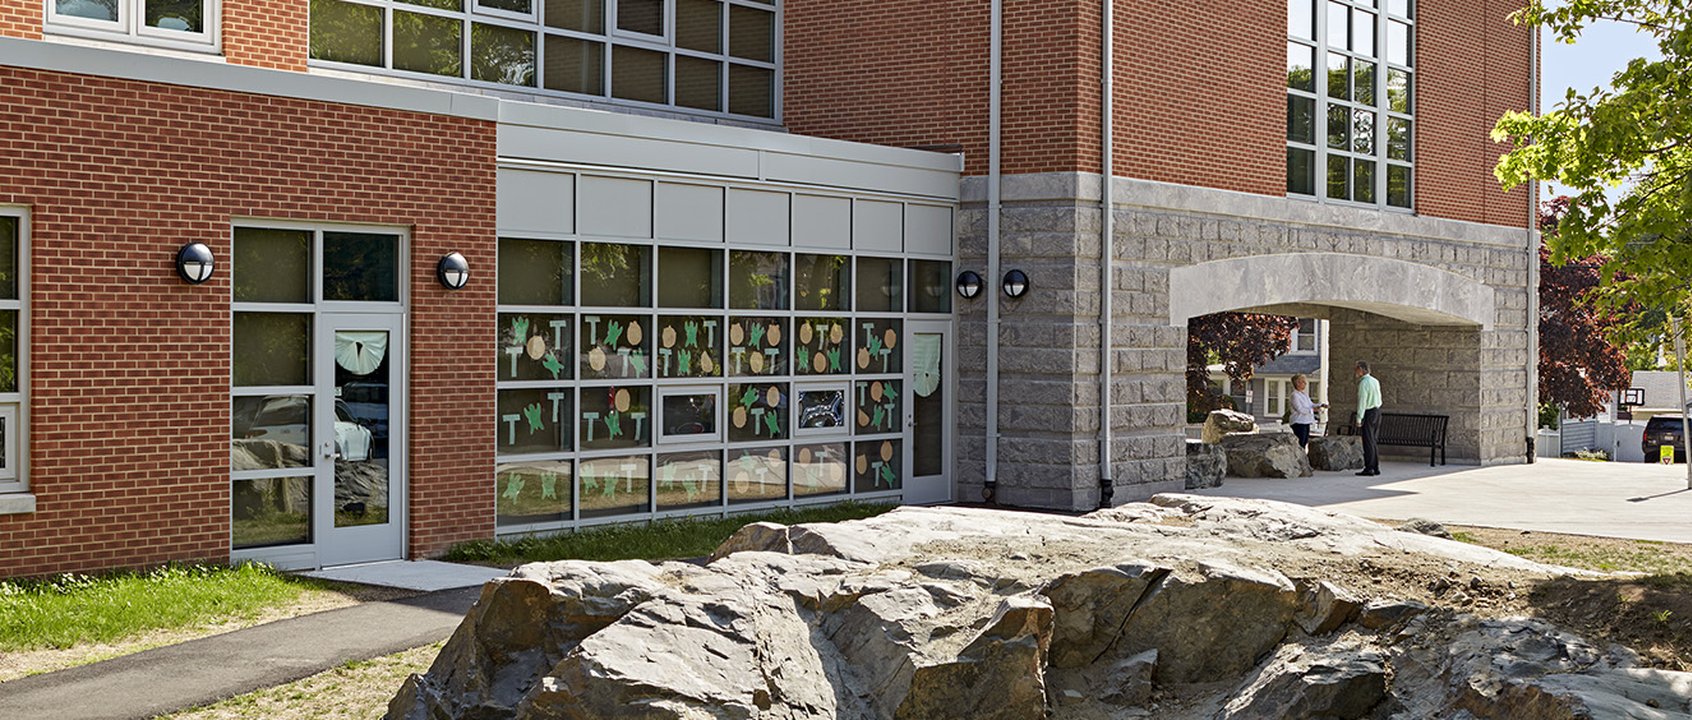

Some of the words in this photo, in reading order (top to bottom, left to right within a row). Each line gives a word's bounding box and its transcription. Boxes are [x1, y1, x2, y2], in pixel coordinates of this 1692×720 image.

[550, 320, 566, 350] T
[585, 316, 600, 345] T
[704, 321, 717, 348] T
[816, 325, 828, 350] T
[862, 323, 874, 348] T
[506, 347, 523, 377] T
[617, 348, 631, 377] T
[659, 349, 672, 376] T
[732, 347, 745, 374] T
[765, 348, 779, 374] T
[880, 349, 891, 372] T
[548, 393, 564, 422] T
[856, 382, 867, 406] T
[502, 414, 520, 444] T
[583, 412, 599, 441] T
[631, 412, 646, 440] T
[751, 408, 764, 435] T
[884, 403, 895, 429] T
[815, 452, 828, 476] T
[872, 462, 883, 487] T
[621, 464, 636, 493] T
[699, 465, 712, 492] T
[756, 468, 769, 494] T
